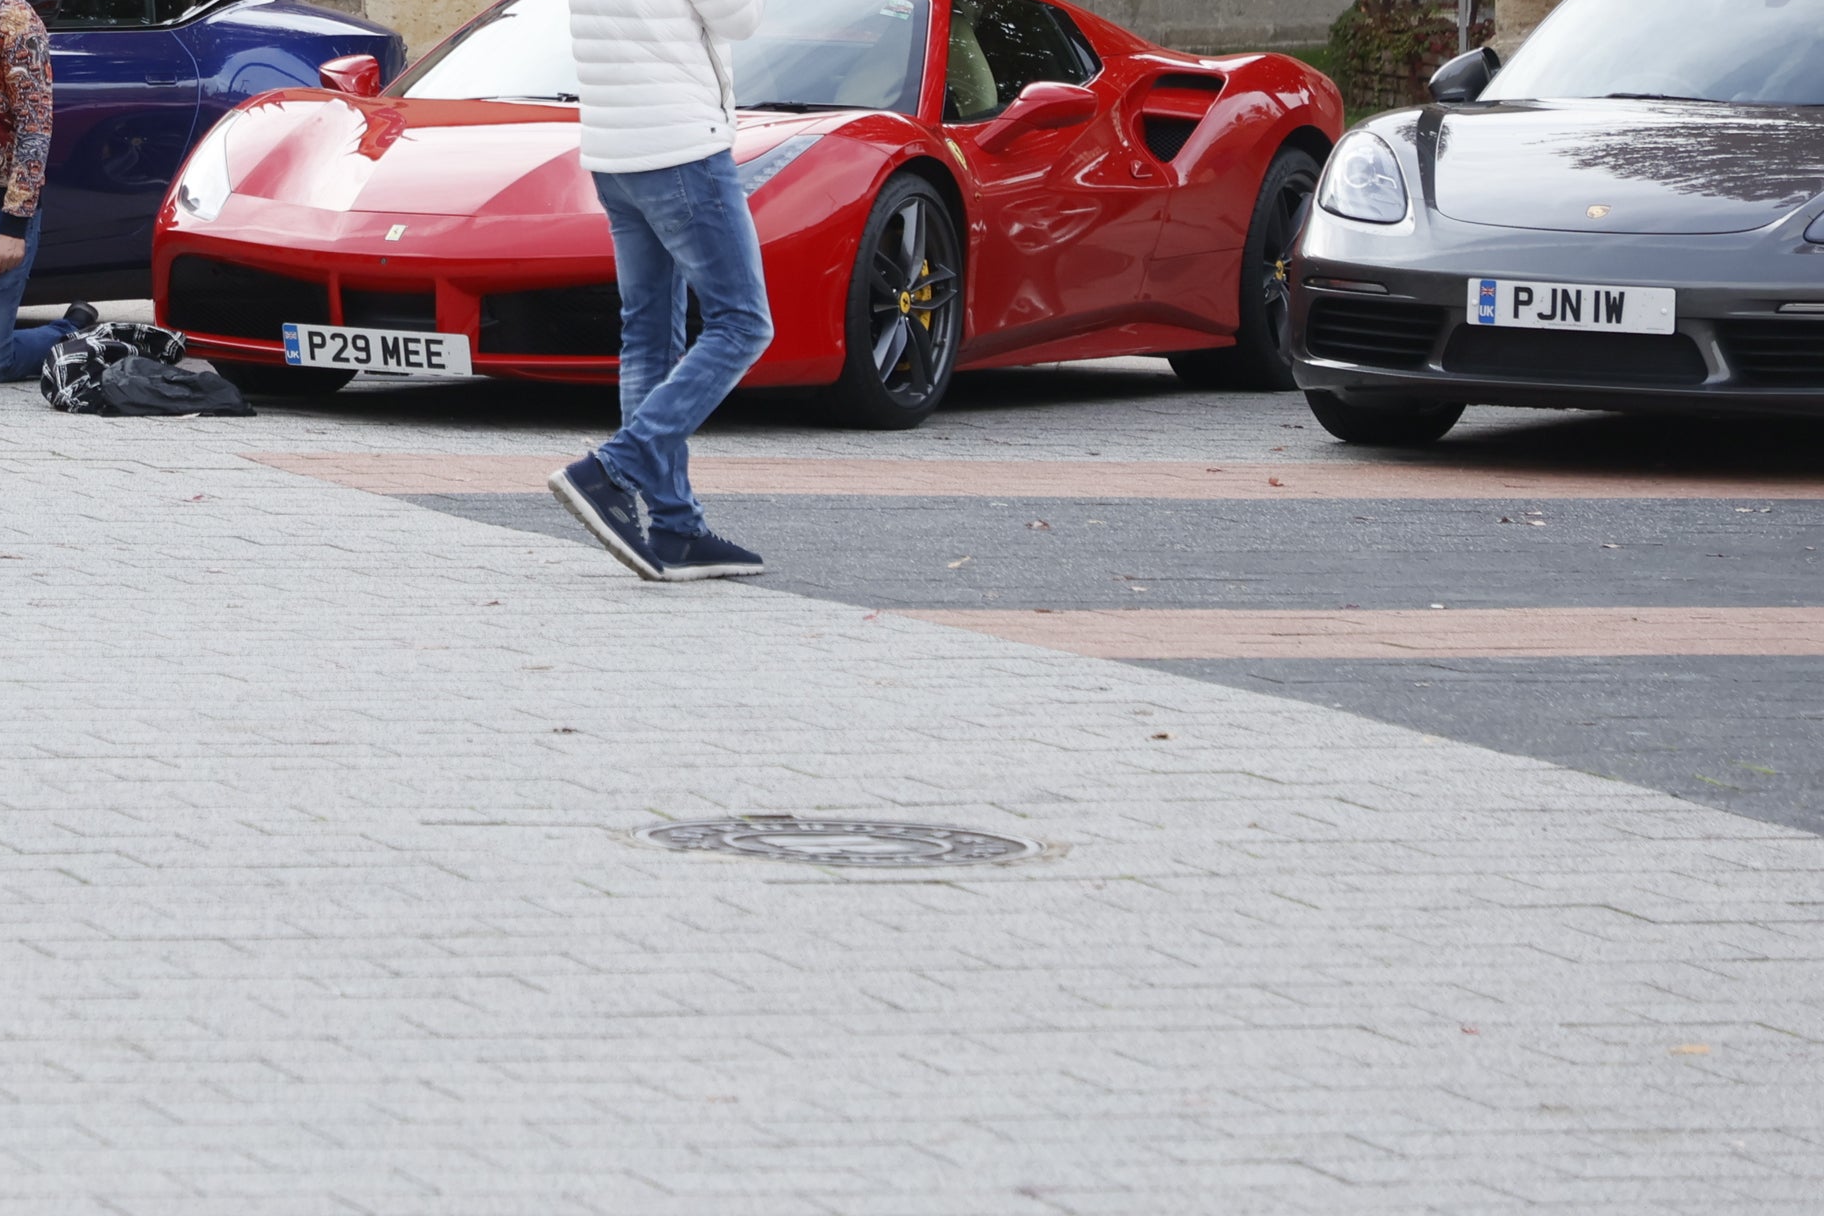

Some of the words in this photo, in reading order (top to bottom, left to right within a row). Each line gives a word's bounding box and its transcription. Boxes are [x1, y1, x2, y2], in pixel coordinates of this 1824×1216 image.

[1479, 305, 1495, 317] UK
[286, 350, 300, 359] UK
[307, 330, 372, 364] P29
[380, 336, 446, 370] MEE
